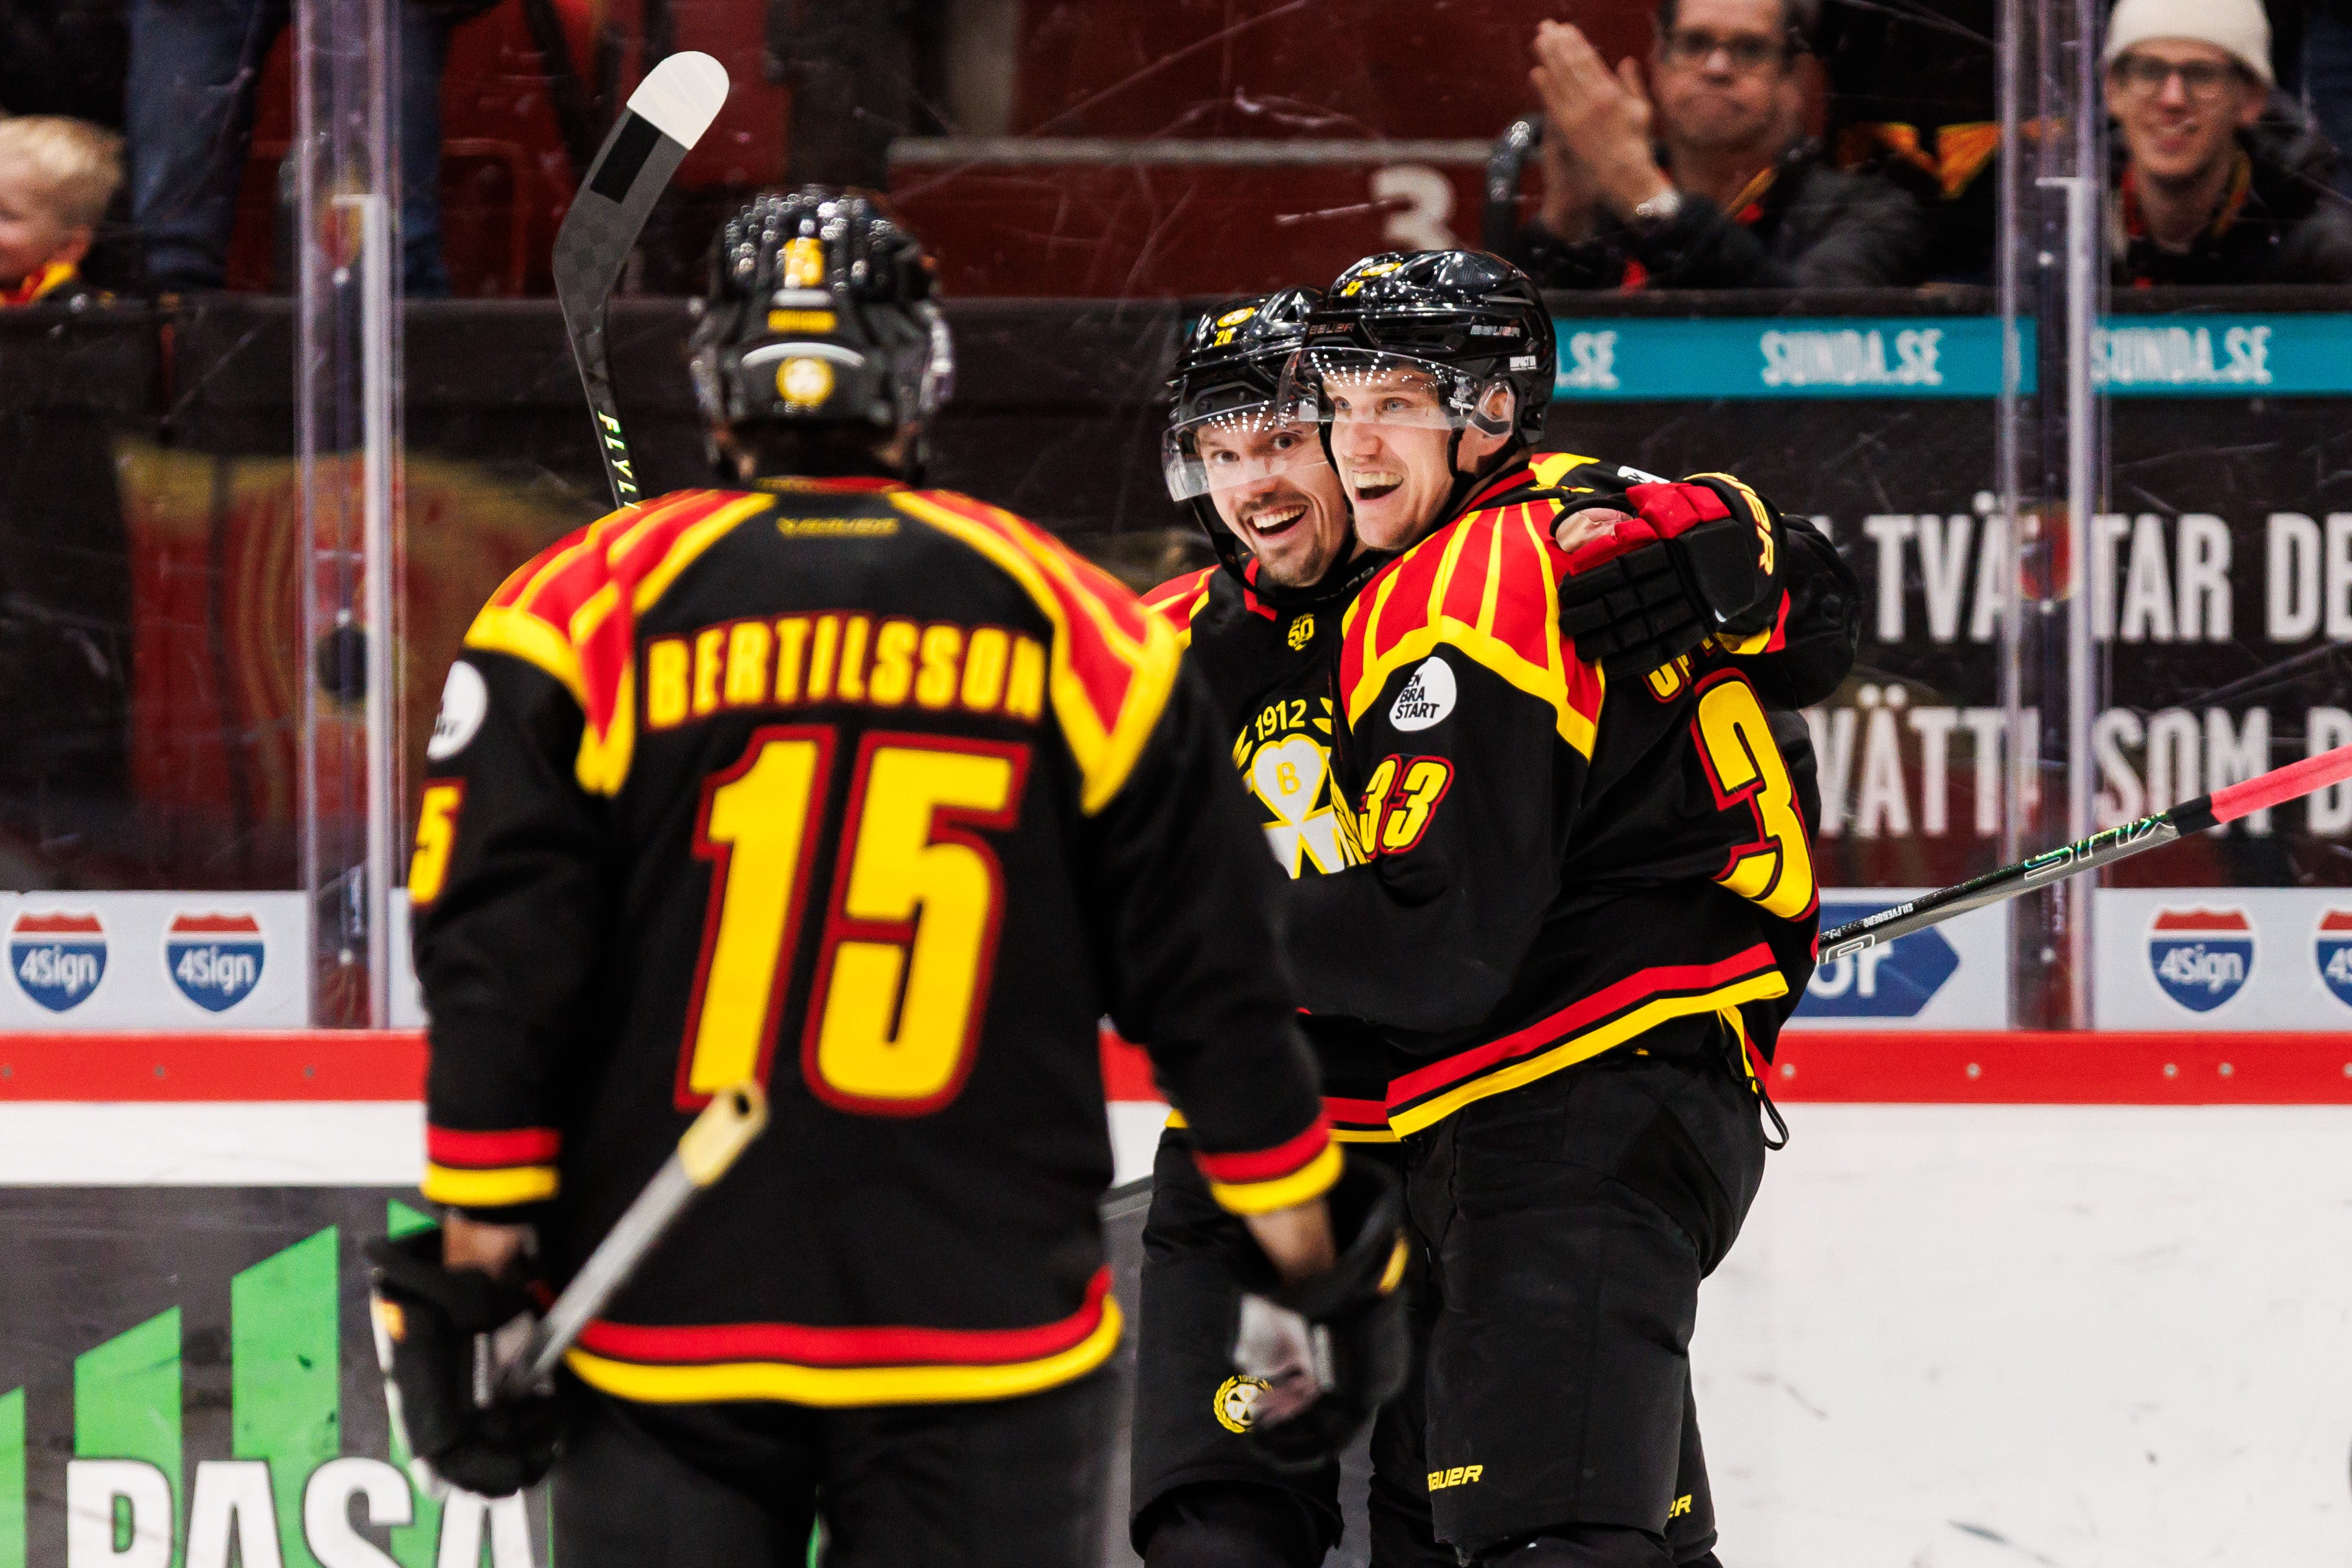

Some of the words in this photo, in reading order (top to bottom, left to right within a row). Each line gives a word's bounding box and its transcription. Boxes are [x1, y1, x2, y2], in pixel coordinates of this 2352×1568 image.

[1761, 329, 1943, 386] SUNDA.SE
[645, 610, 1049, 731] BERTILSSON
[1400, 686, 1425, 703] BRA
[1256, 700, 1306, 741] 1912
[1395, 703, 1440, 719] START
[2091, 706, 2273, 837] SOM
[1359, 754, 1455, 860] 33
[675, 726, 1031, 1118] 15
[19, 944, 98, 996] 4Sign
[176, 944, 255, 996] 4Sign
[2159, 943, 2245, 994] 4Sign
